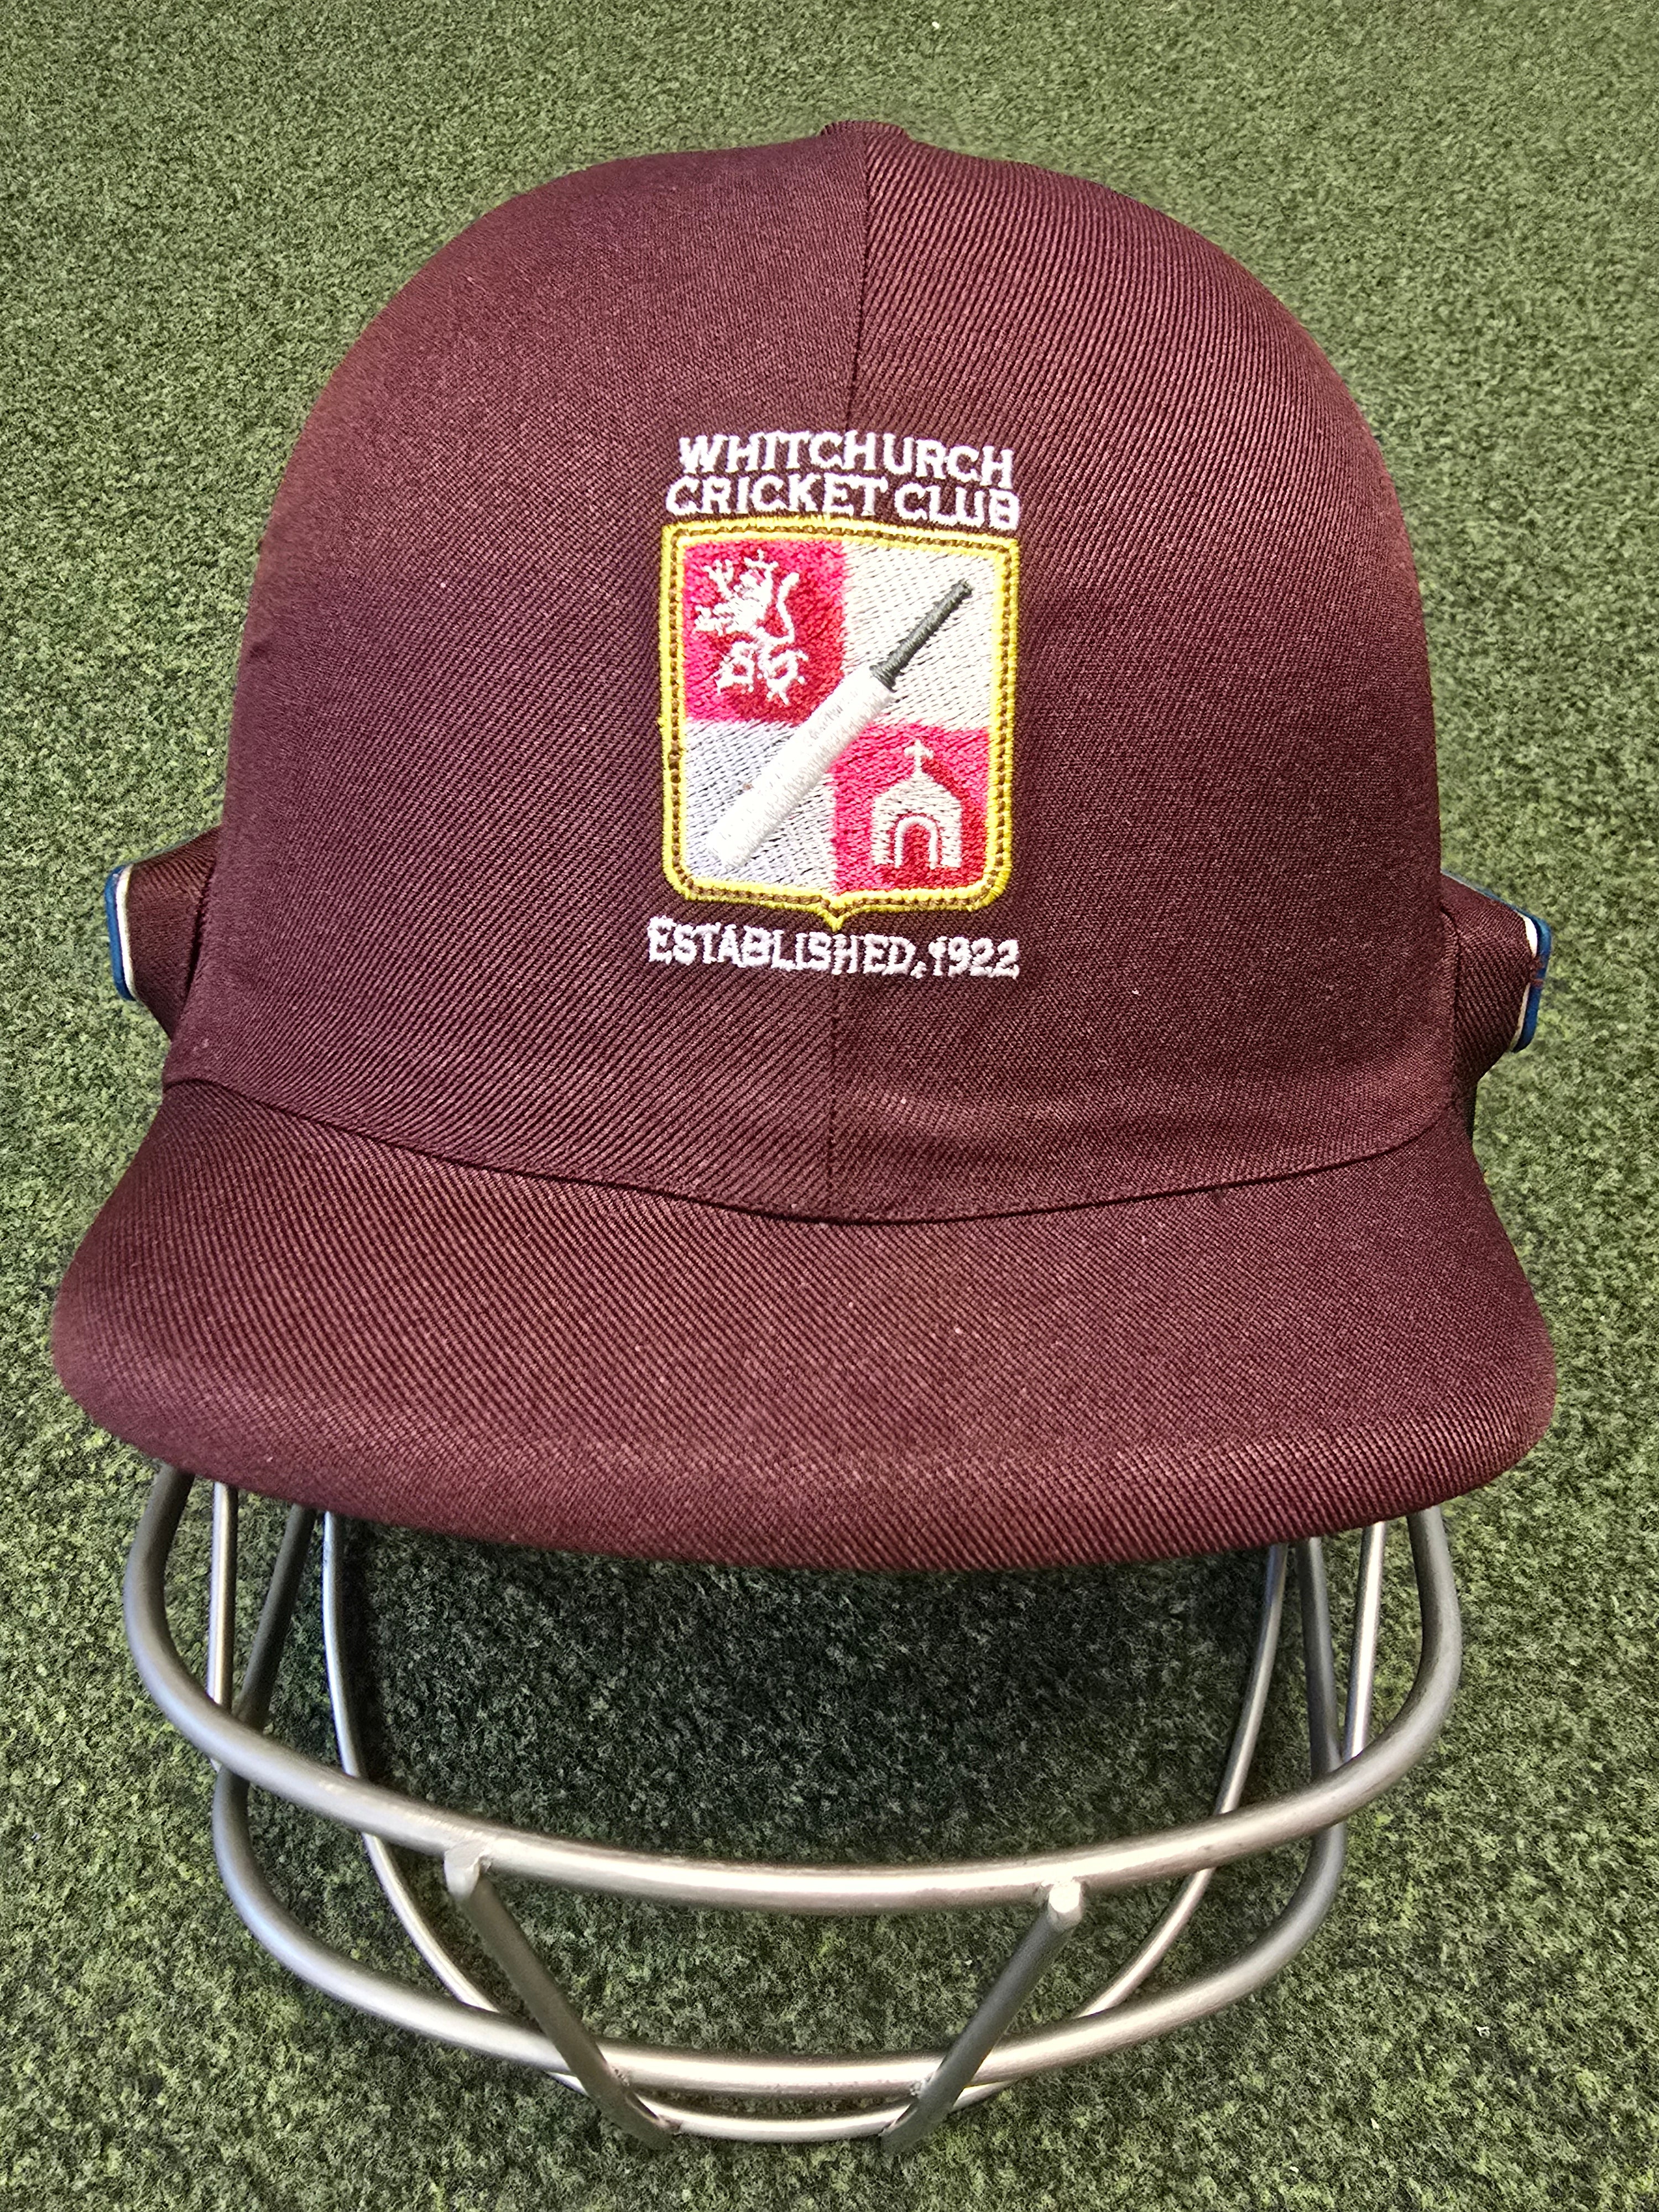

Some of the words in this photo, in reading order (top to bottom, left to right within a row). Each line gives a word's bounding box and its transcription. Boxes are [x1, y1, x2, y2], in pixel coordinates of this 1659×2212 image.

[679, 430, 1014, 489] WHITCHURCH
[665, 472, 889, 517] CRICKET
[894, 482, 1020, 531] CLUB
